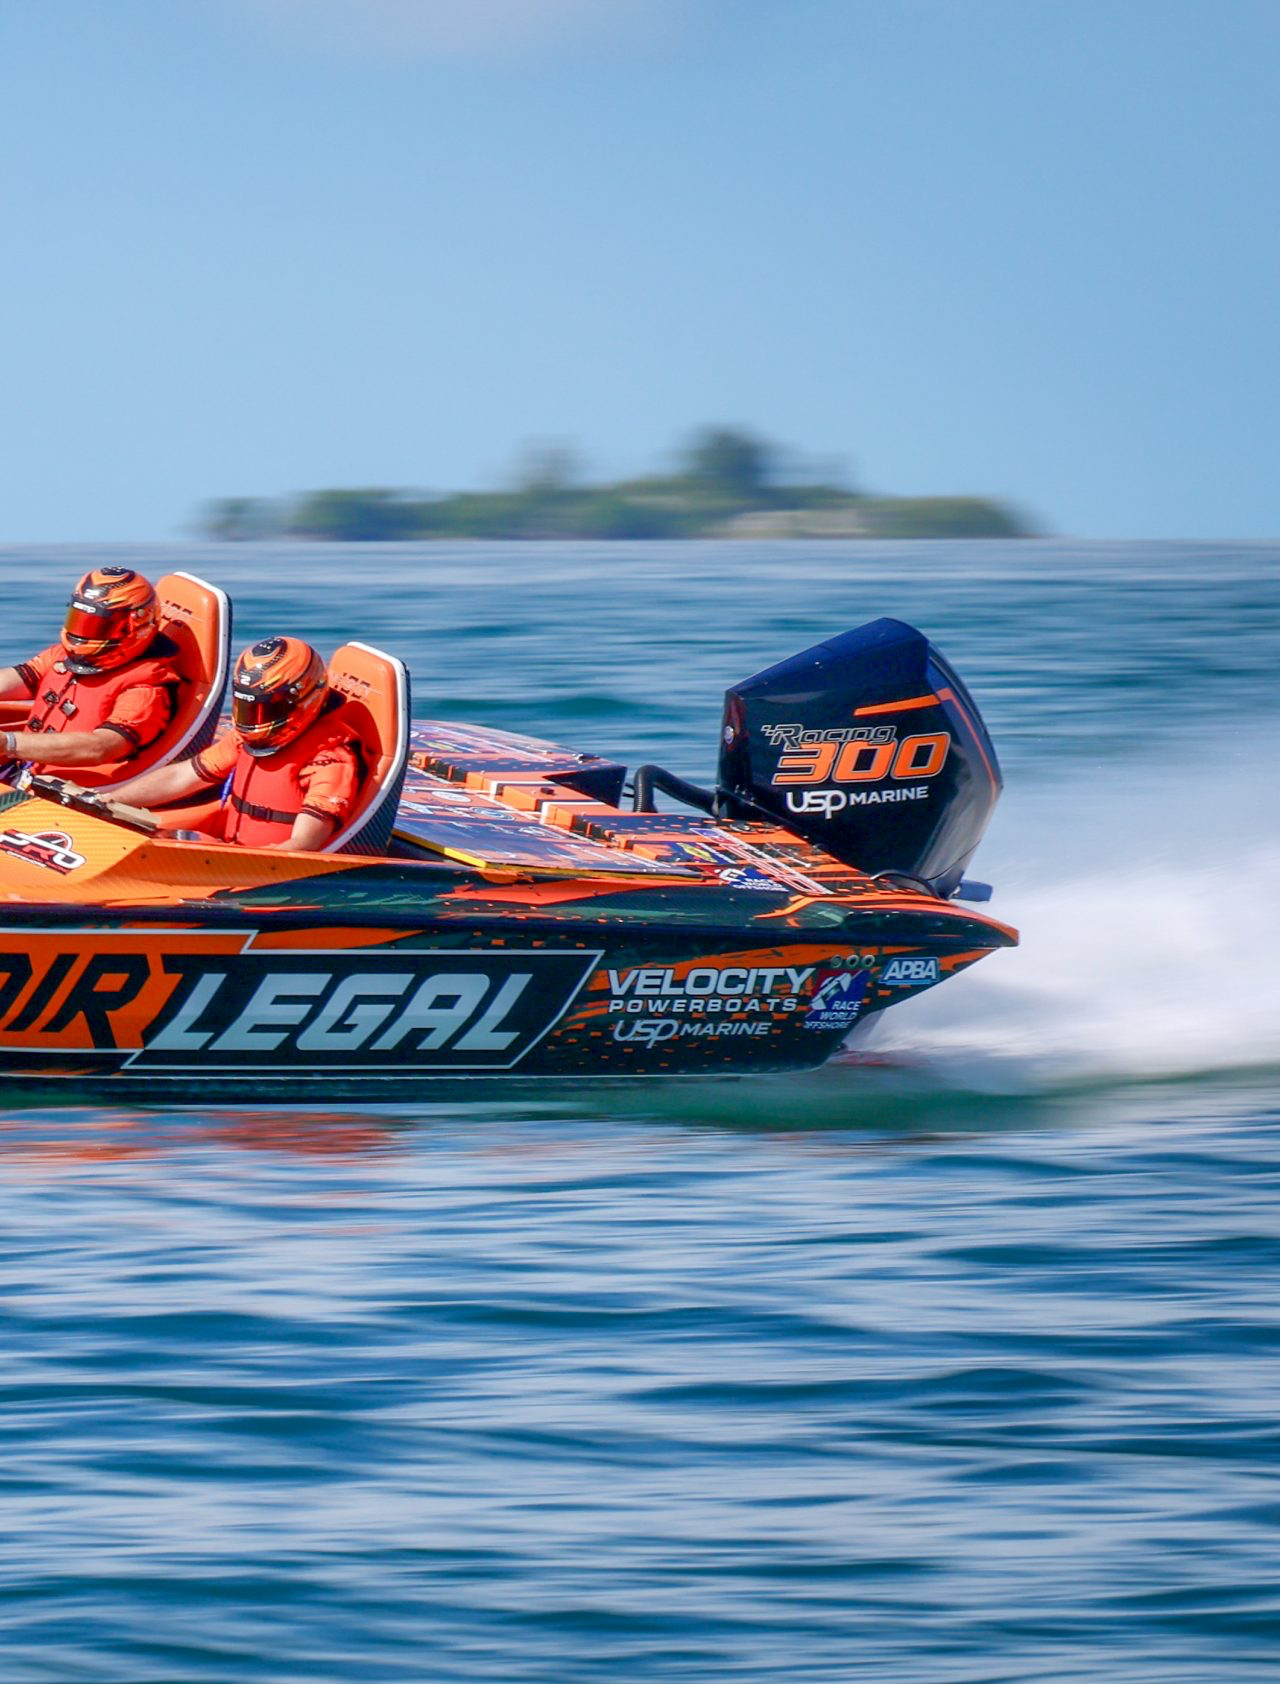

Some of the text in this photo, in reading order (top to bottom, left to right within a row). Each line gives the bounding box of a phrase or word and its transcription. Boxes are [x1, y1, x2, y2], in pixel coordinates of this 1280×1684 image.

[761, 724, 898, 749] Racing
[771, 731, 952, 786] 300
[849, 785, 929, 806] MARINE
[883, 959, 938, 981] APBA
[608, 967, 817, 996] VELOCITY
[144, 972, 534, 1051] LEGAL
[608, 998, 798, 1013] POWERBOATS
[820, 1011, 858, 1021] WORLD
[831, 1000, 861, 1012] RACE
[679, 1021, 772, 1036] MARINE
